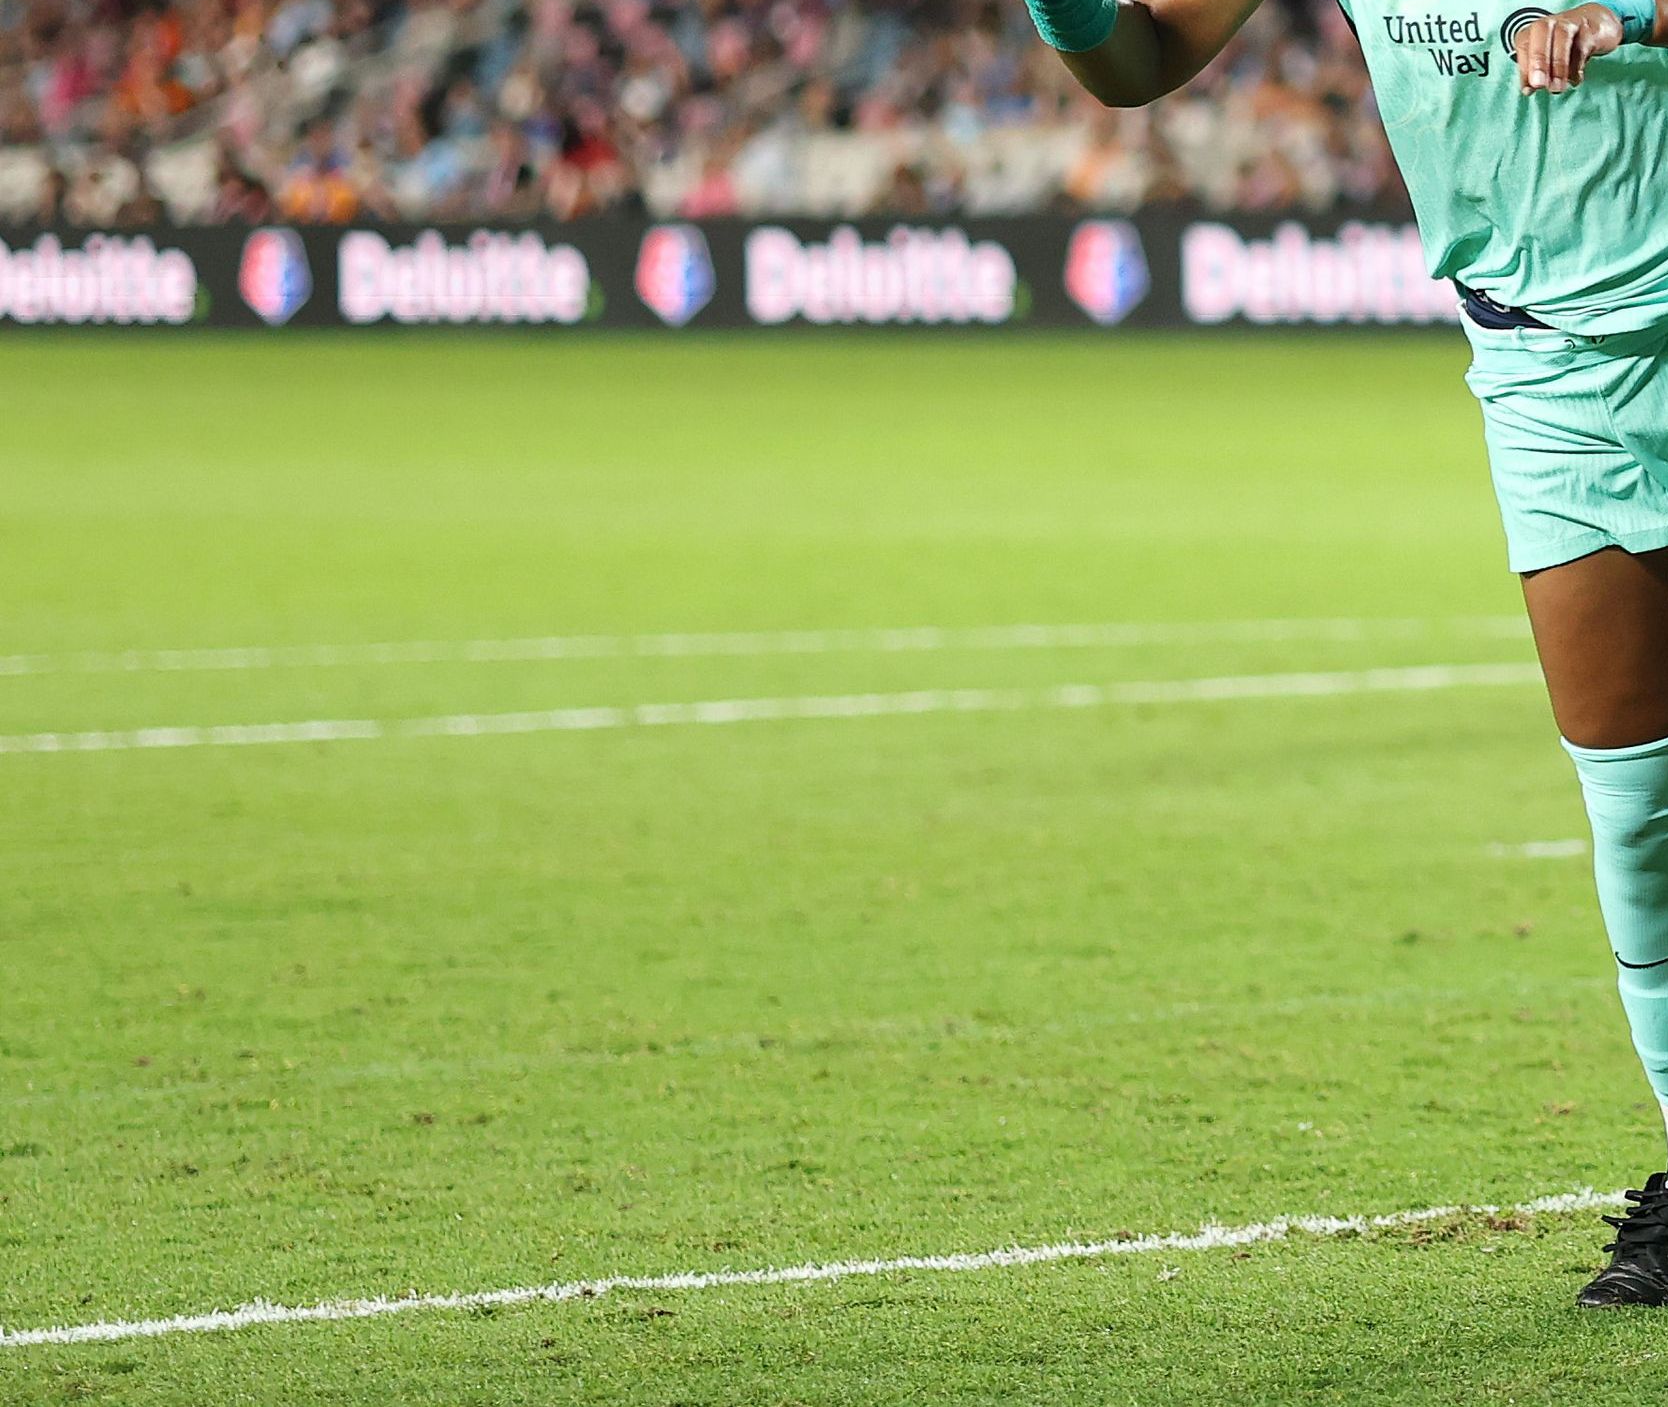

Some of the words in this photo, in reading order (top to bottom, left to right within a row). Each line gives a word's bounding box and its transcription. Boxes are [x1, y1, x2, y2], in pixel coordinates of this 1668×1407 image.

[1383, 12, 1484, 43] United
[1428, 48, 1490, 77] Way
[0, 231, 197, 324] eloitte
[745, 226, 1018, 324] Deloitte
